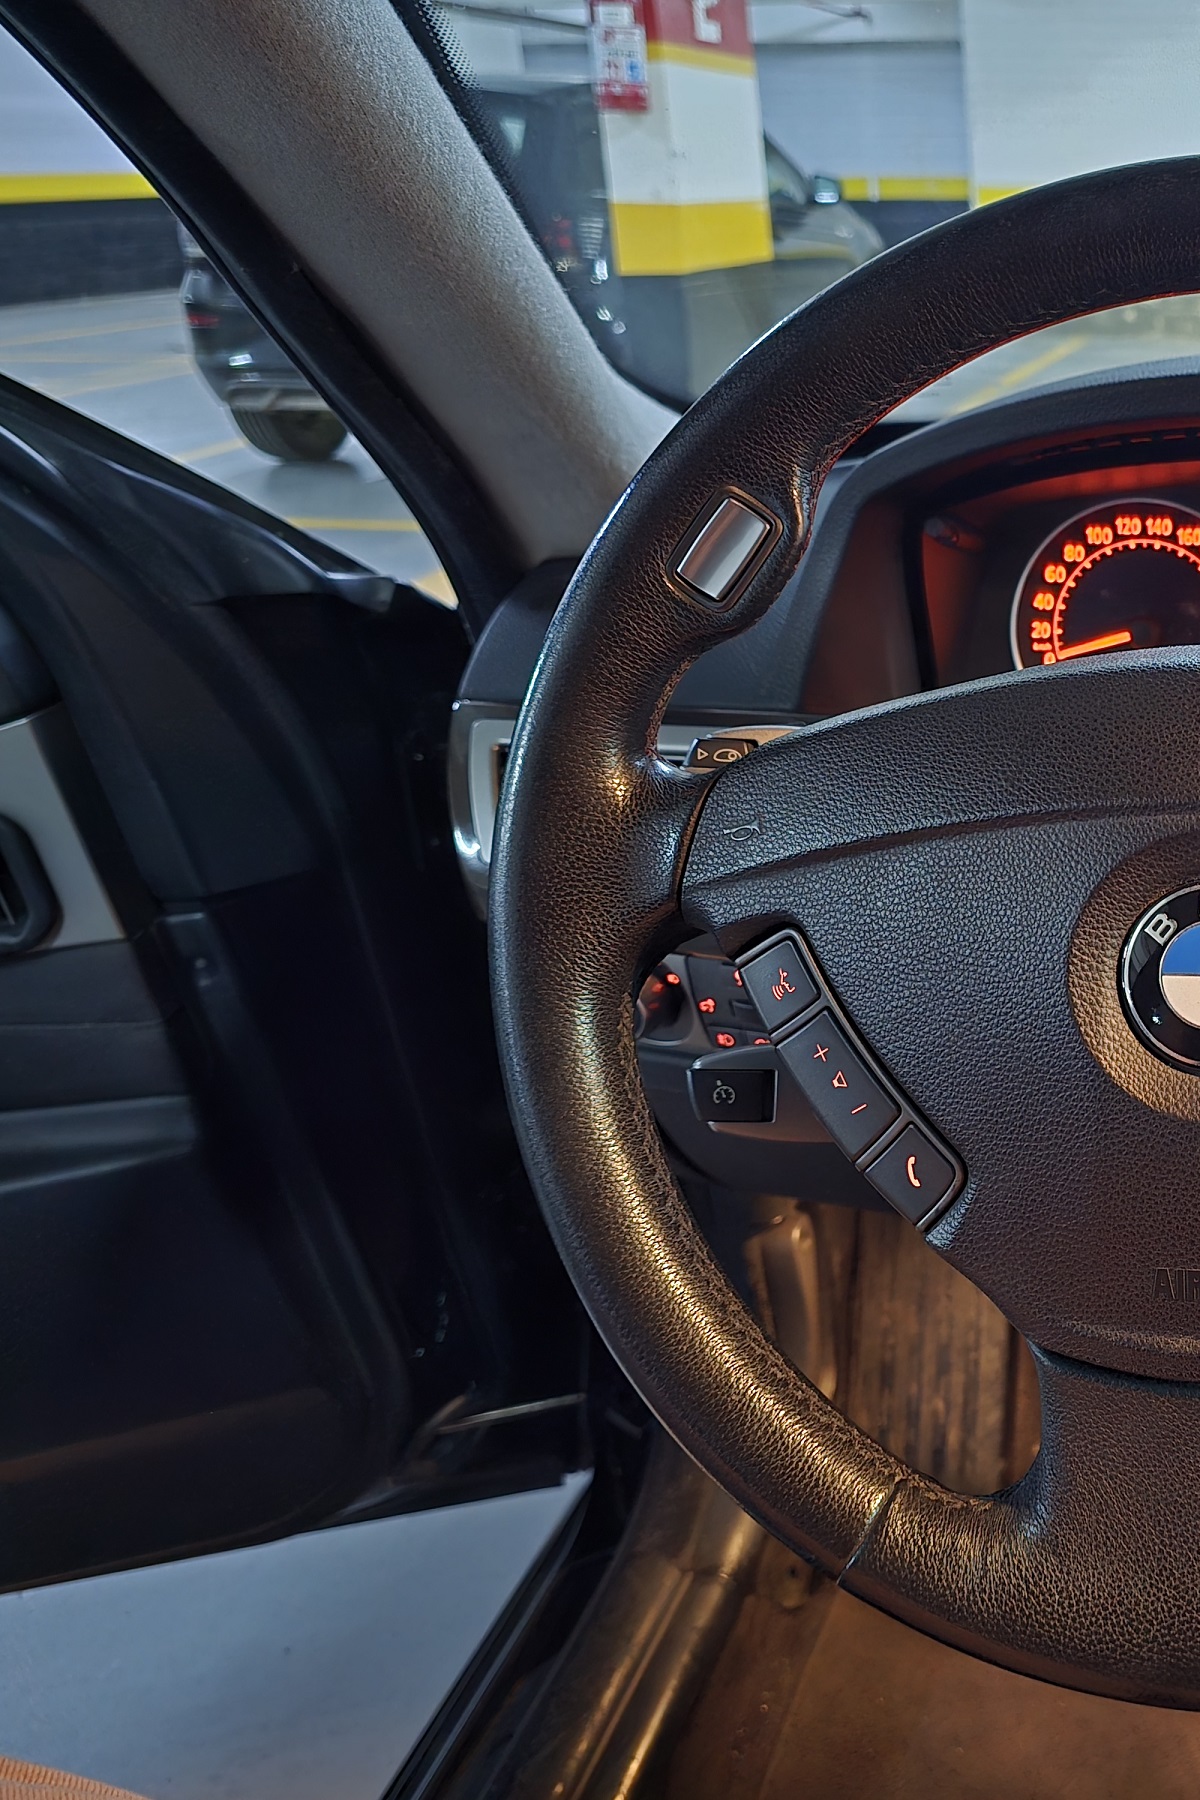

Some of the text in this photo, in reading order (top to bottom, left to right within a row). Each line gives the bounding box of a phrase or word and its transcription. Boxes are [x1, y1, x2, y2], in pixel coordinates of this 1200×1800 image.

[1086, 526, 1113, 545] 100
[1115, 516, 1142, 536] 120
[1145, 516, 1173, 537] 140
[1063, 543, 1086, 563] 80
[1044, 564, 1067, 583] 60
[1033, 593, 1055, 611] 40
[1031, 621, 1052, 640] 20
